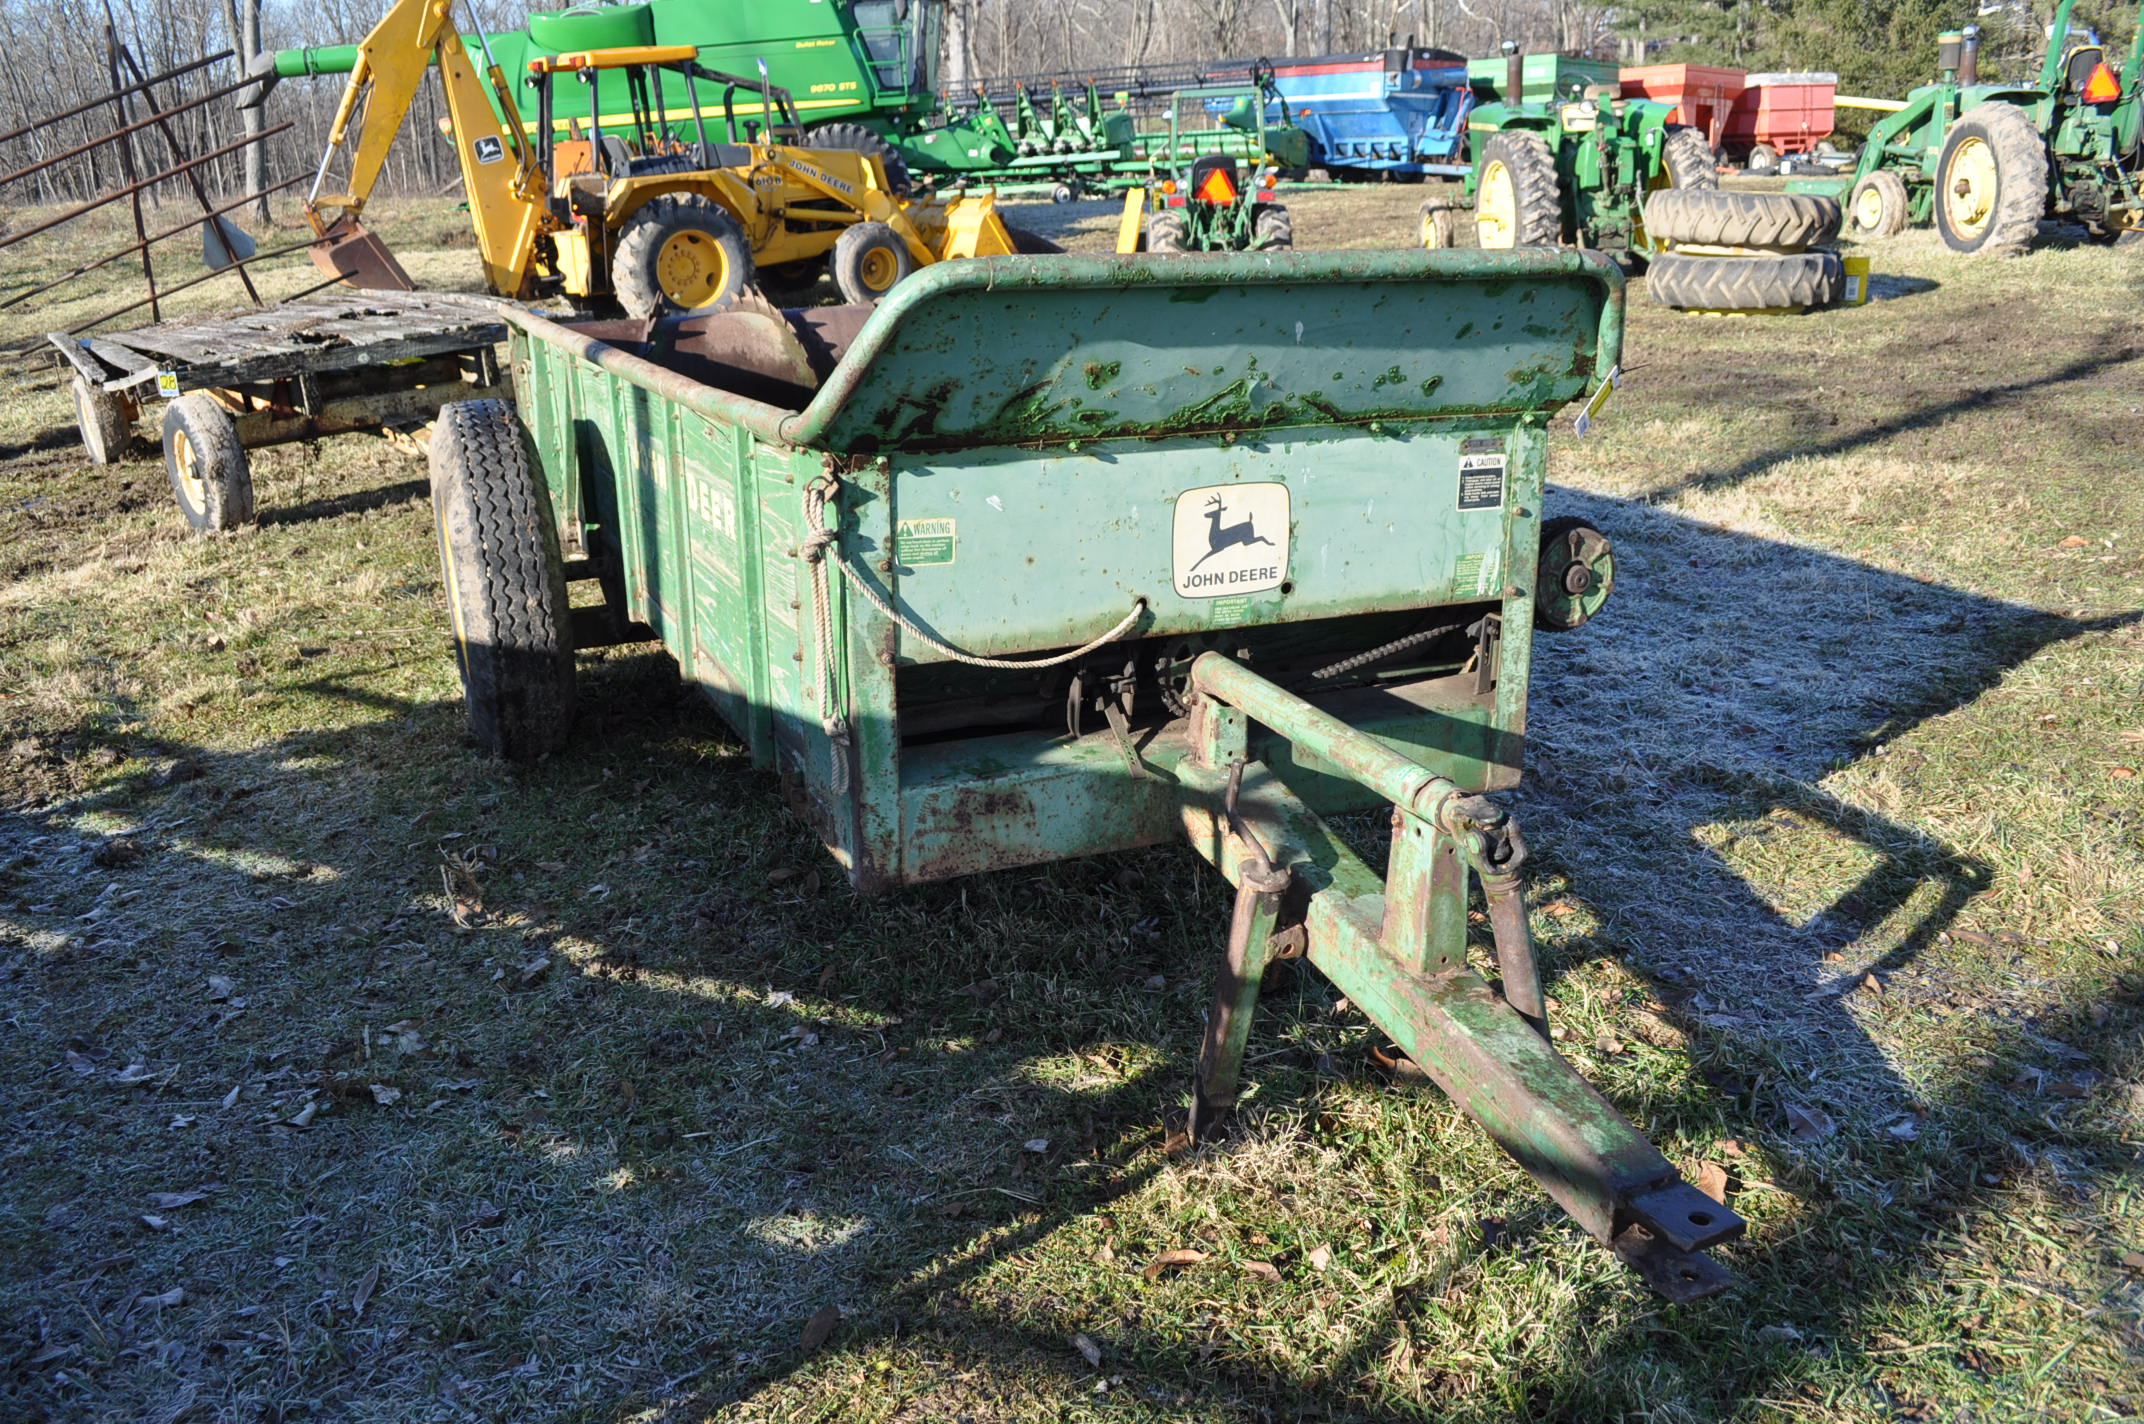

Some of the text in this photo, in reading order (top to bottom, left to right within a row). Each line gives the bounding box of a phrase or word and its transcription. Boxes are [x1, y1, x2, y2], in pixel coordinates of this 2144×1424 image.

[789, 160, 853, 195] JOHN DEERE
[1477, 457, 1502, 467] CAUTION
[913, 521, 951, 536] WARNING
[1183, 566, 1278, 588] JOHN DEERE
